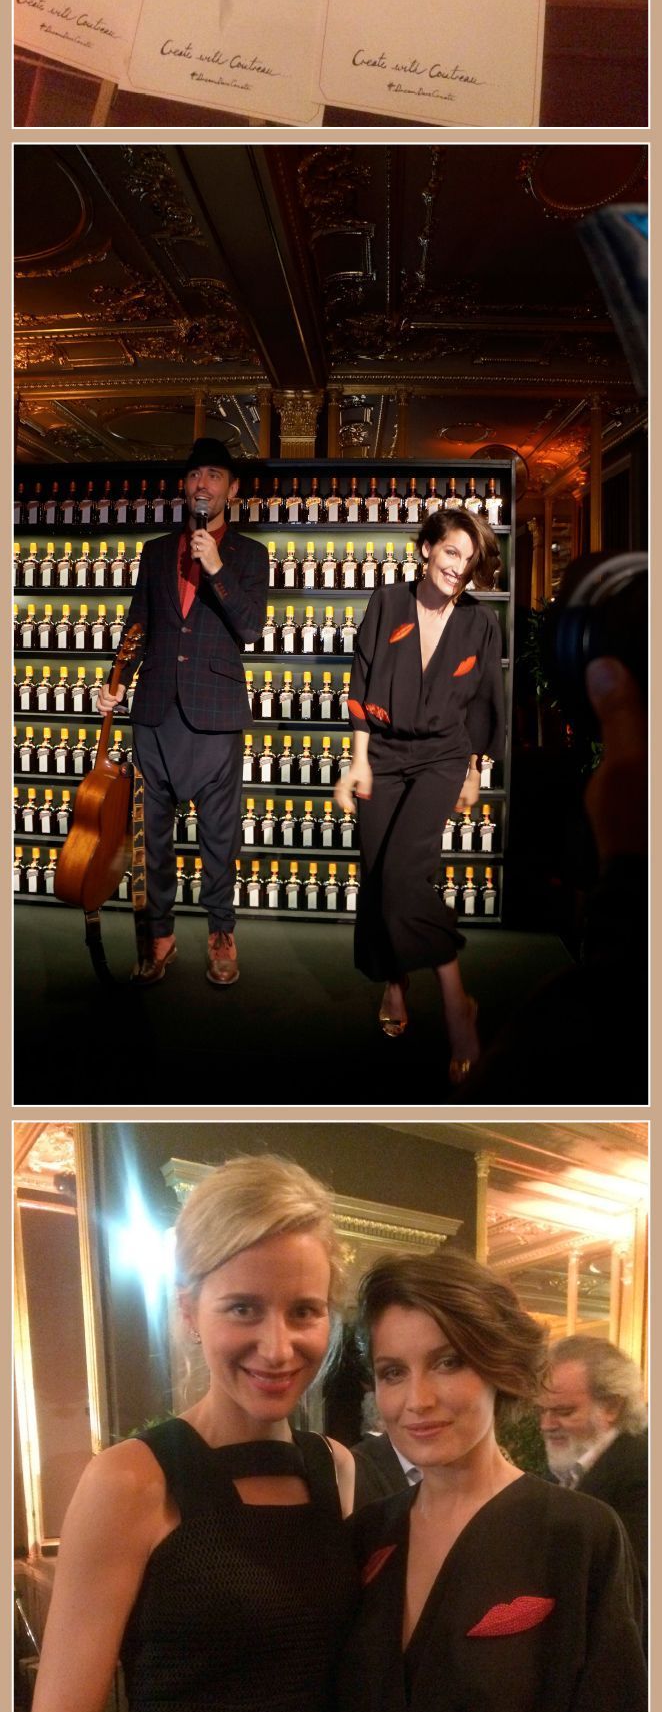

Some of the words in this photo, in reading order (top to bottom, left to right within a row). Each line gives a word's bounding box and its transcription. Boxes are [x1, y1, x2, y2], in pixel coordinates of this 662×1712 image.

[76, 14, 122, 38] Cointreau
[160, 39, 192, 59] Create
[229, 54, 280, 76] Cointreau
[352, 49, 387, 69] Create
[428, 63, 486, 85] Cointreau
